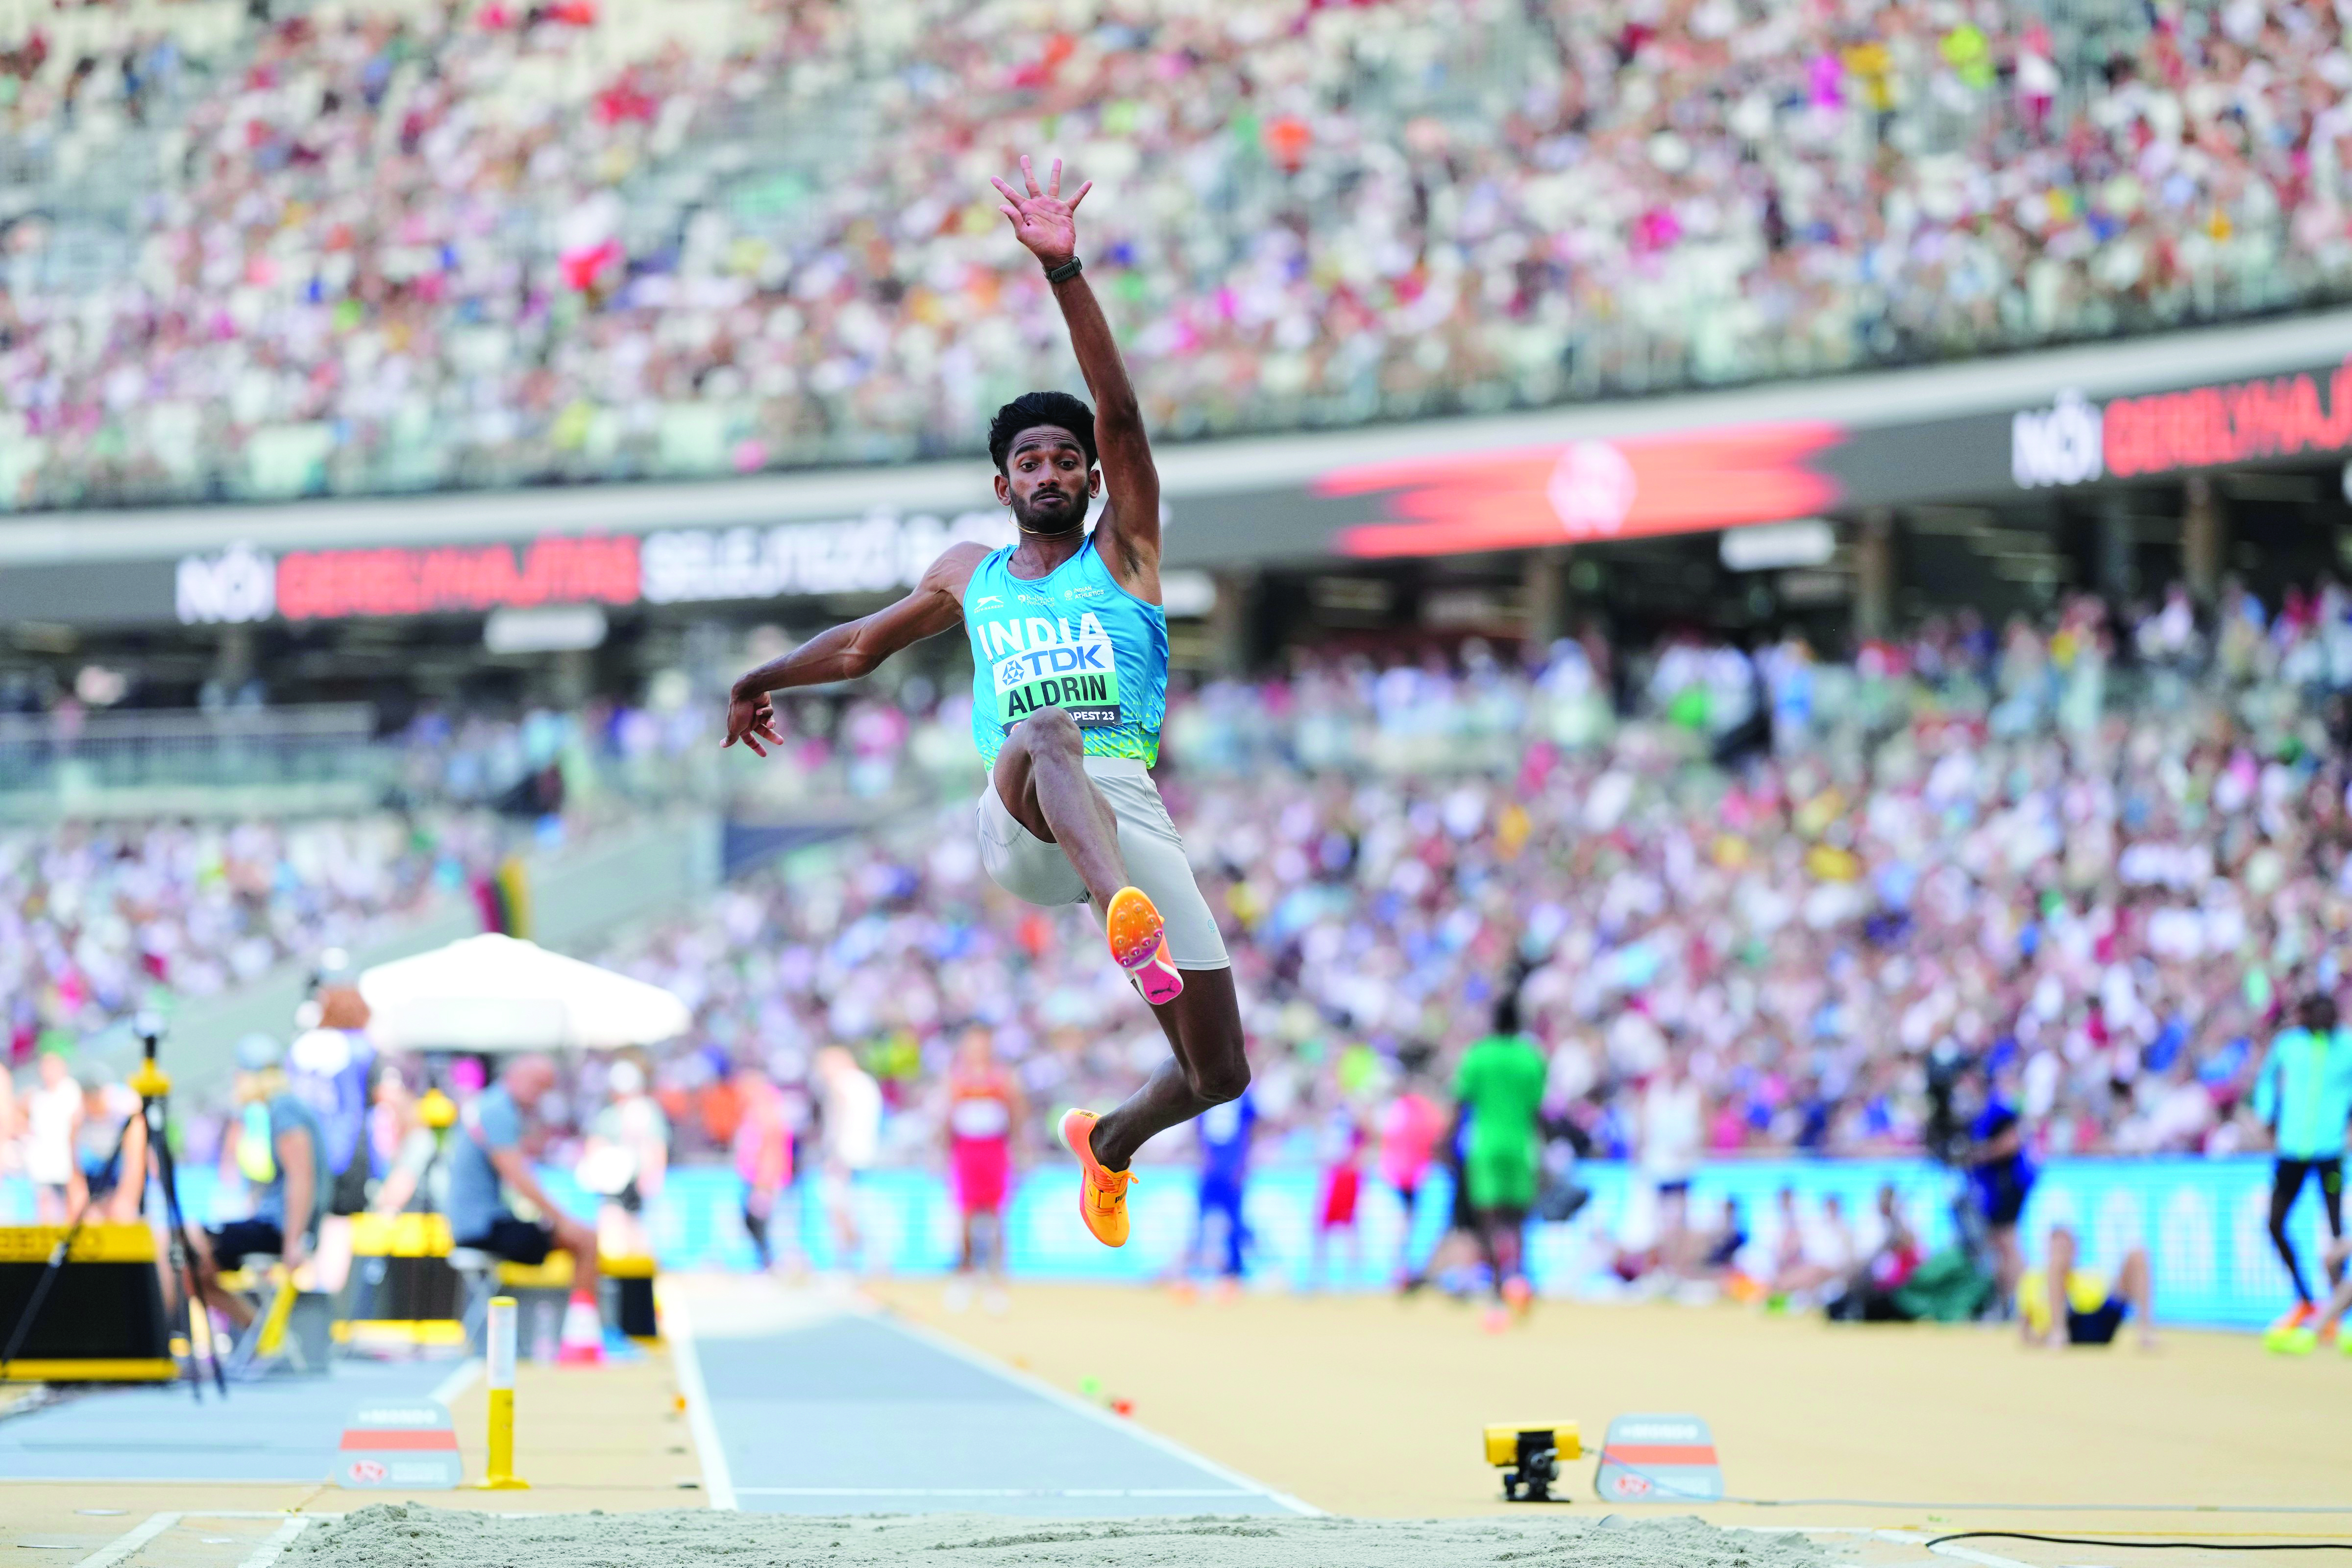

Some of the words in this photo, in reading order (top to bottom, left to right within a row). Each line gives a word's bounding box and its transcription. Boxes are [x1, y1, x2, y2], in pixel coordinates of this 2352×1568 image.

[1075, 589, 1104, 599] ATHLETICS
[974, 604, 1004, 614] SHIV-NARESH
[977, 612, 1113, 660] INDIA
[1022, 644, 1106, 676] TDK
[1008, 675, 1107, 717] ALDRIN
[1101, 711, 1115, 720] 23
